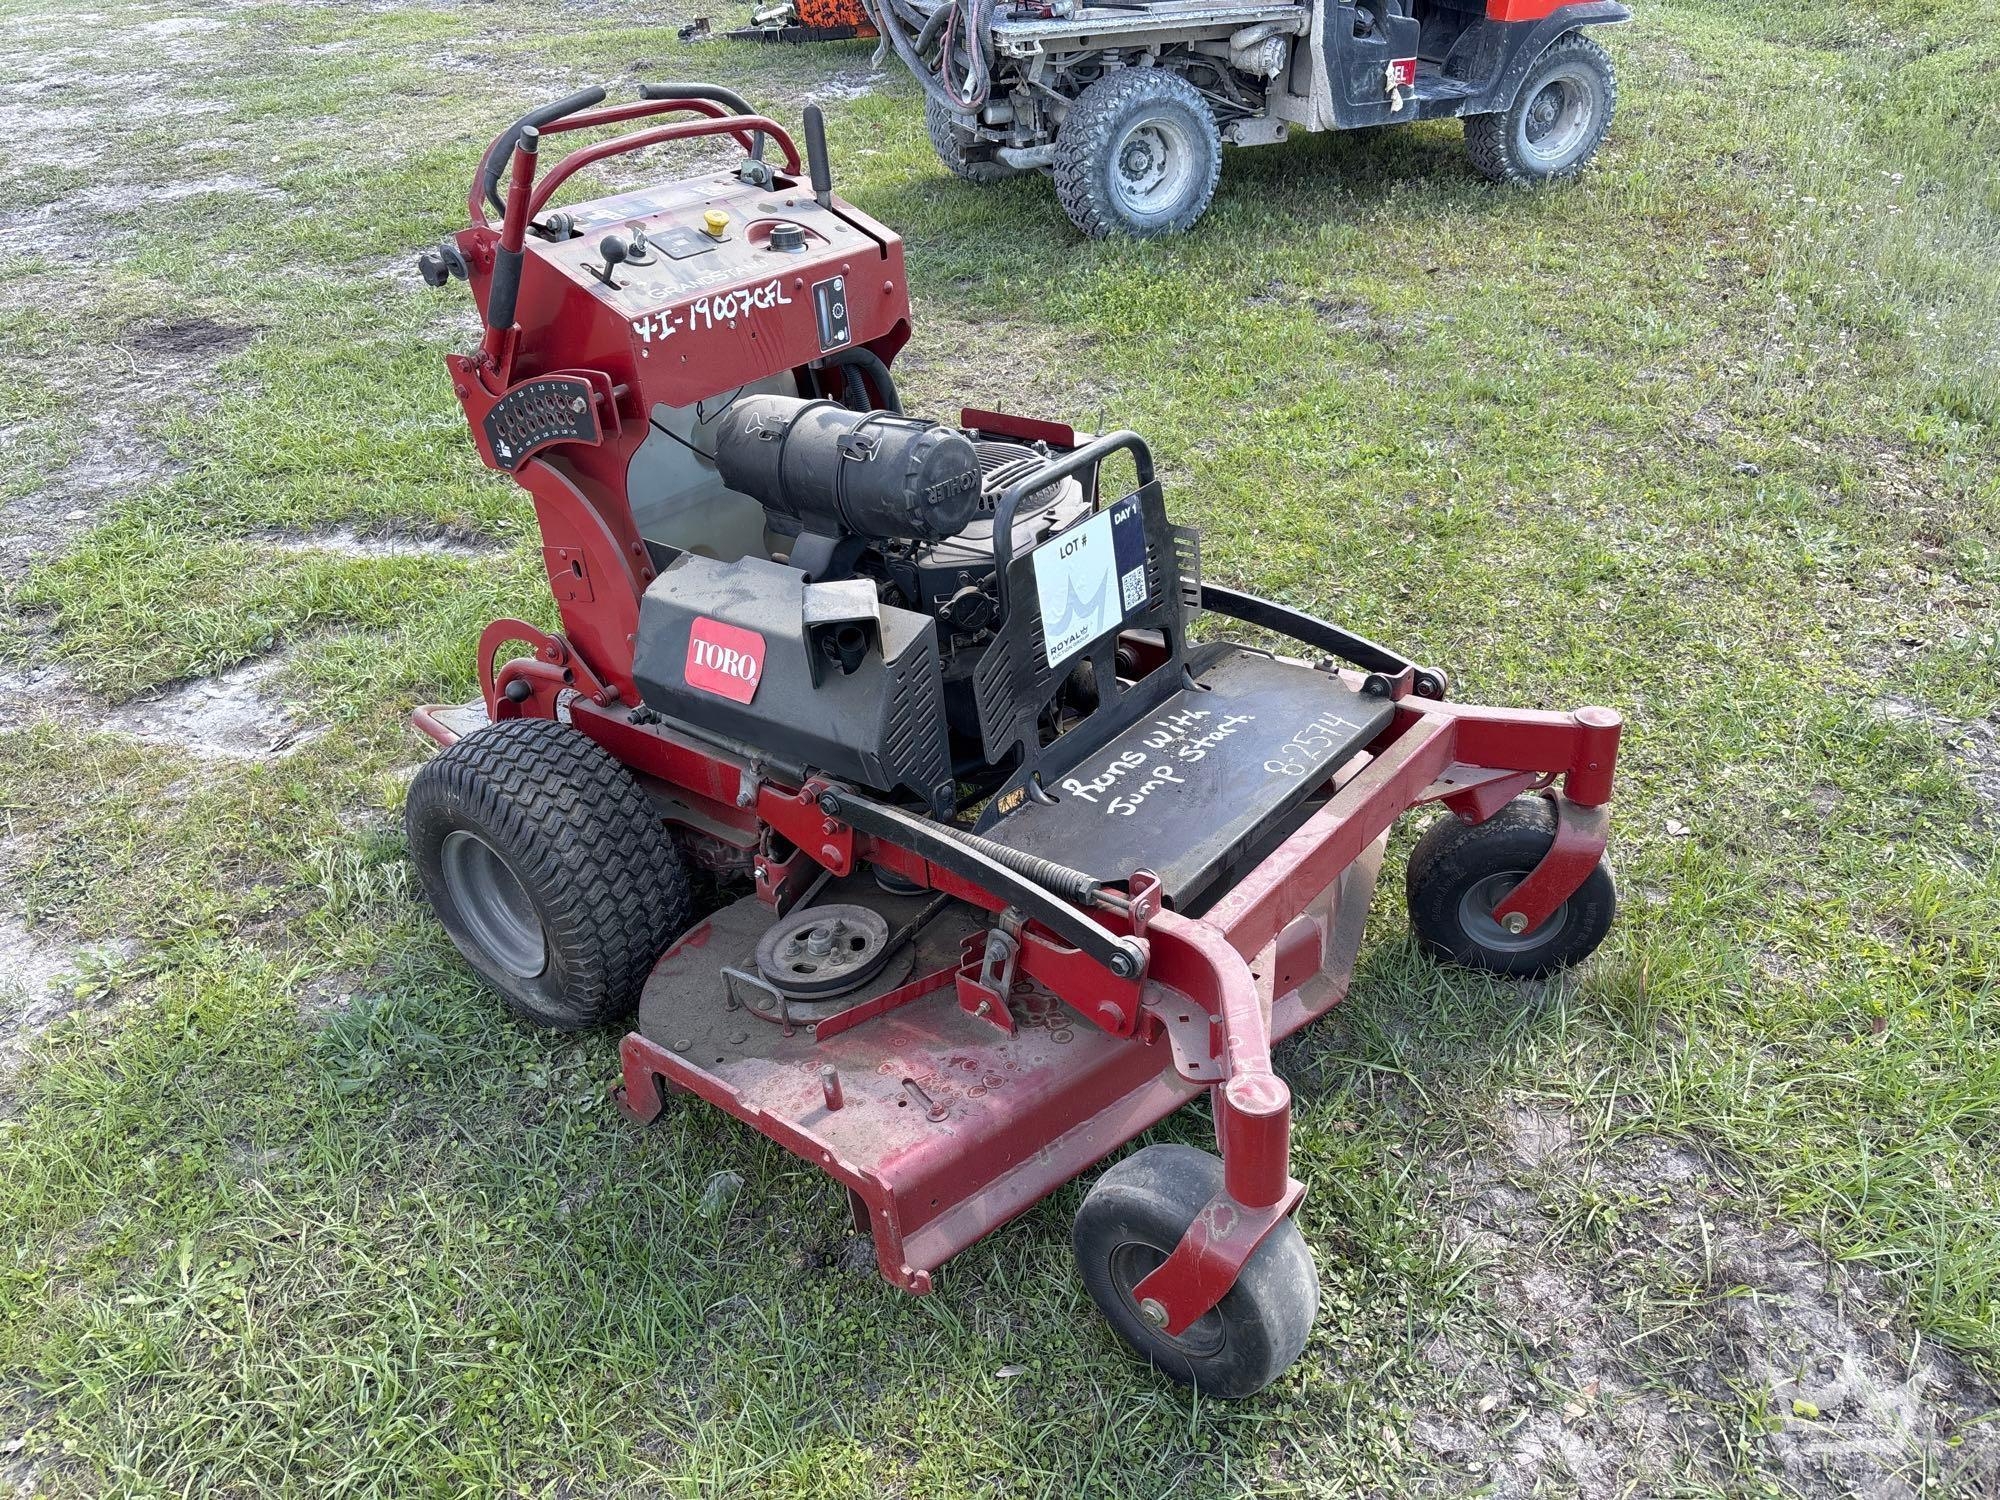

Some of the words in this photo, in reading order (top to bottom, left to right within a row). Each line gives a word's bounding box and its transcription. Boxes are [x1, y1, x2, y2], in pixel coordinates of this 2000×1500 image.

[649, 259, 768, 299] GRANDSTAND
[925, 469, 978, 504] KOHLER
[1114, 508, 1130, 525] DAY
[1131, 504, 1137, 514] 1
[1060, 538, 1079, 560] LOT
[1082, 533, 1088, 547] #
[693, 638, 757, 681] TORO
[1050, 632, 1081, 656] ROYAL
[1263, 712, 1361, 776] 8-2574
[1062, 751, 1147, 803] Runs
[1106, 765, 1186, 816] Jump
